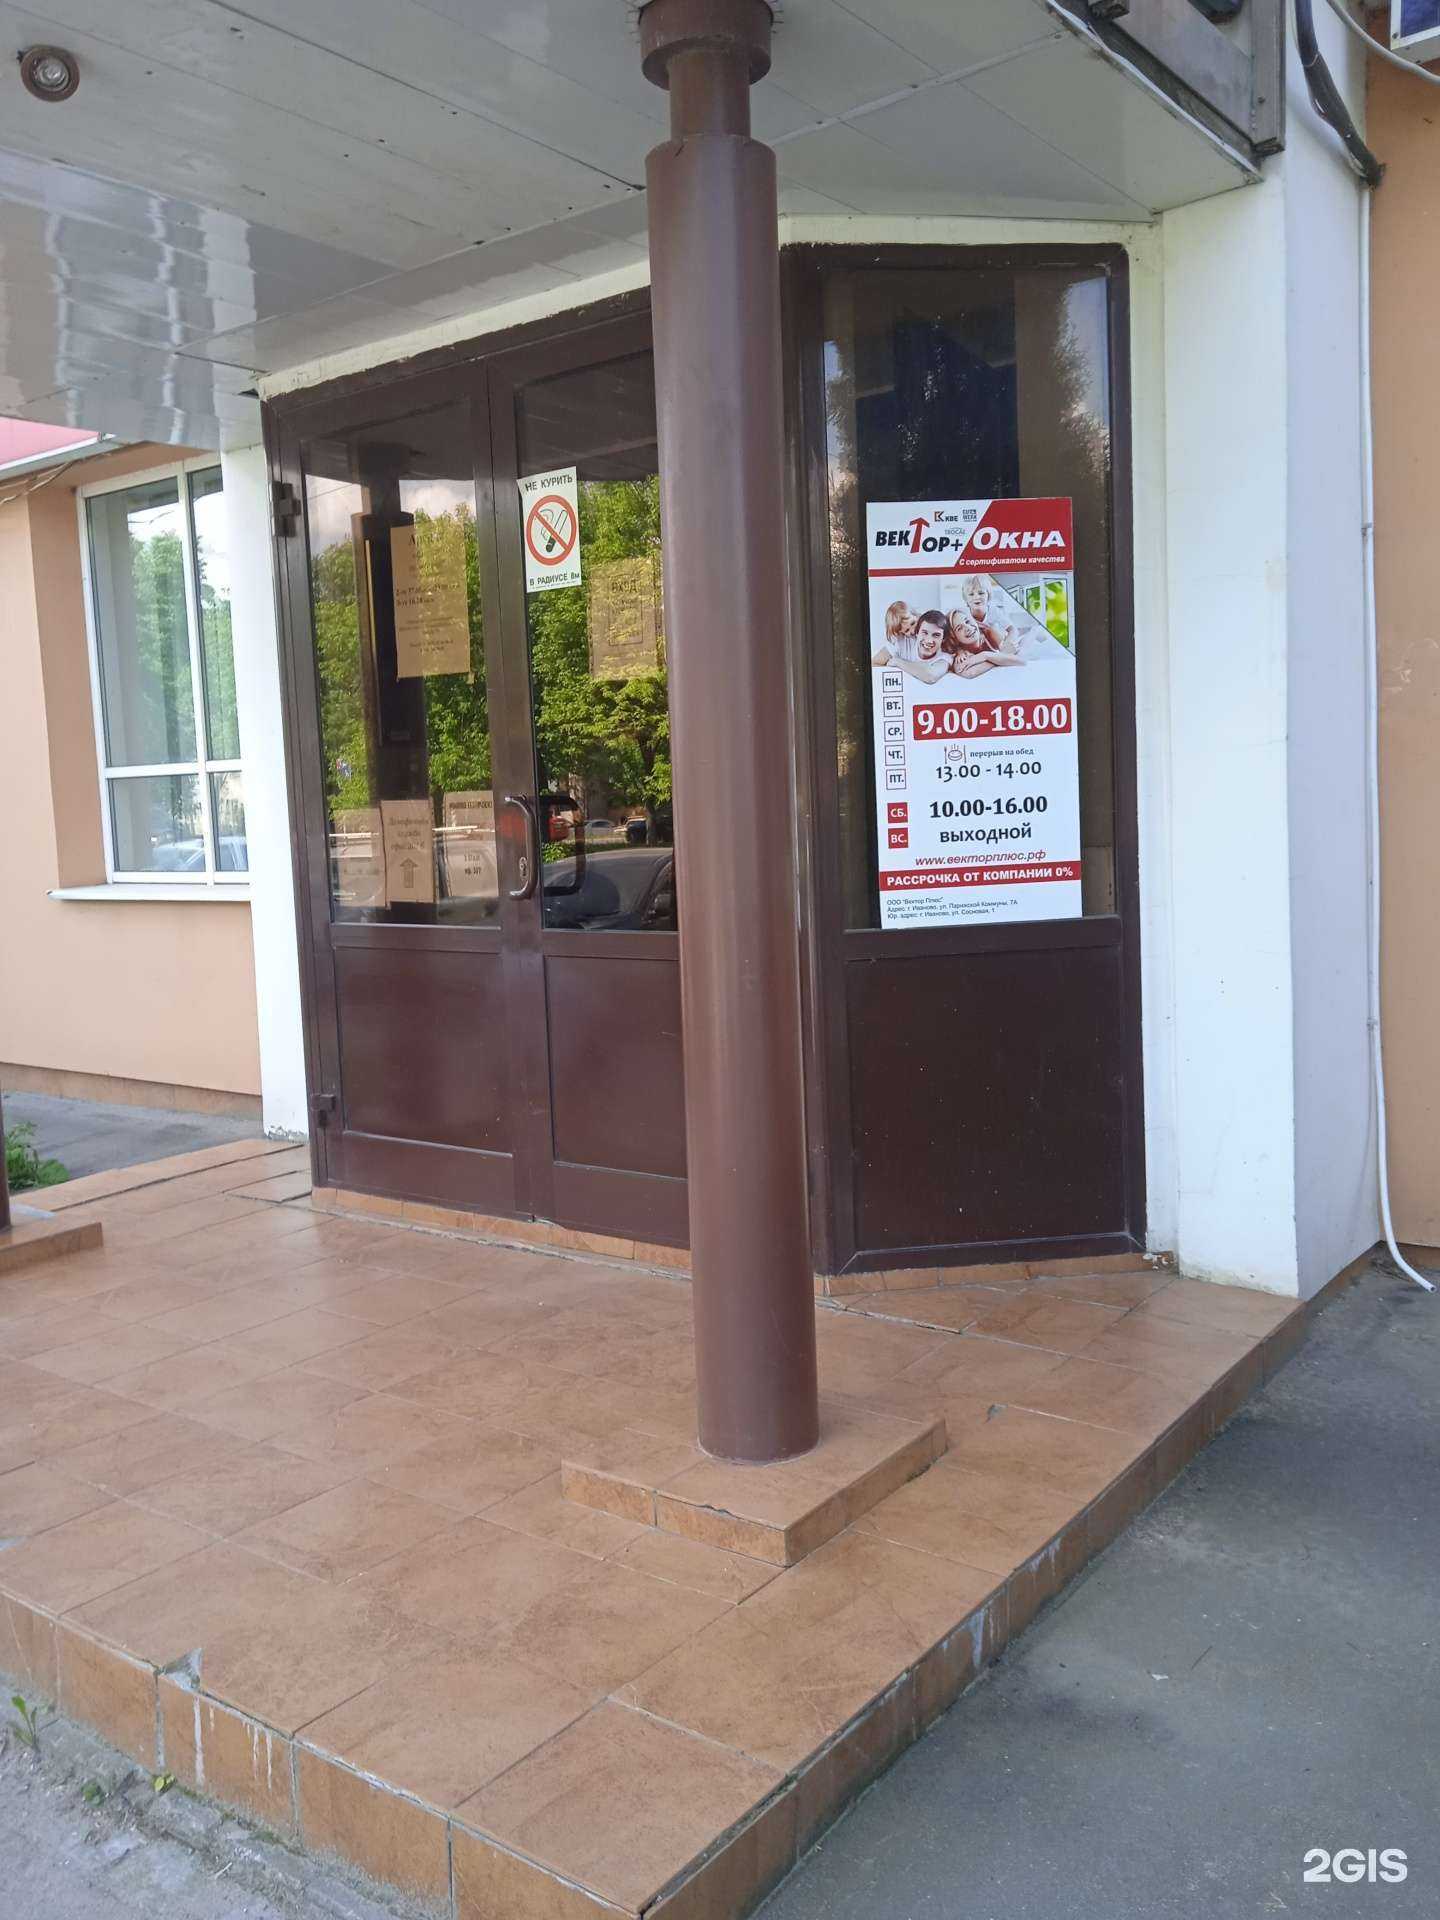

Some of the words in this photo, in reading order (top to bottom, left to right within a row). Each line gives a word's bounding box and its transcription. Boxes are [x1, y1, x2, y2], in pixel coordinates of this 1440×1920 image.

[525, 480, 538, 492] НЕ
[540, 473, 573, 489] КУРИТЬ
[965, 556, 1027, 567] сертификатом
[1028, 555, 1066, 565] качества
[529, 577, 535, 586] В
[537, 573, 568, 586] РАДИУСЕ
[885, 677, 902, 687] ПН.
[886, 701, 902, 711] ВТ.
[917, 703, 1068, 735] 9.00-18.00
[887, 726, 903, 736] СР.
[888, 750, 904, 760] ЧТ.
[970, 748, 1003, 758] перерыв
[1004, 749, 1014, 757] на
[1015, 746, 1035, 756] обед
[935, 764, 981, 783] 13.00
[996, 761, 1041, 779] 14.00
[889, 774, 905, 784] ПТ.
[890, 808, 907, 818] СБ.
[929, 796, 1048, 819] 10.00-16.00
[890, 834, 907, 844] ВС.
[915, 849, 1046, 867] www.векторплюс.рф
[886, 873, 960, 887] РАССРОЧКА
[963, 872, 979, 882] ОТ
[983, 868, 1052, 881] КОМПАНИИ
[1055, 866, 1073, 877] 0%
